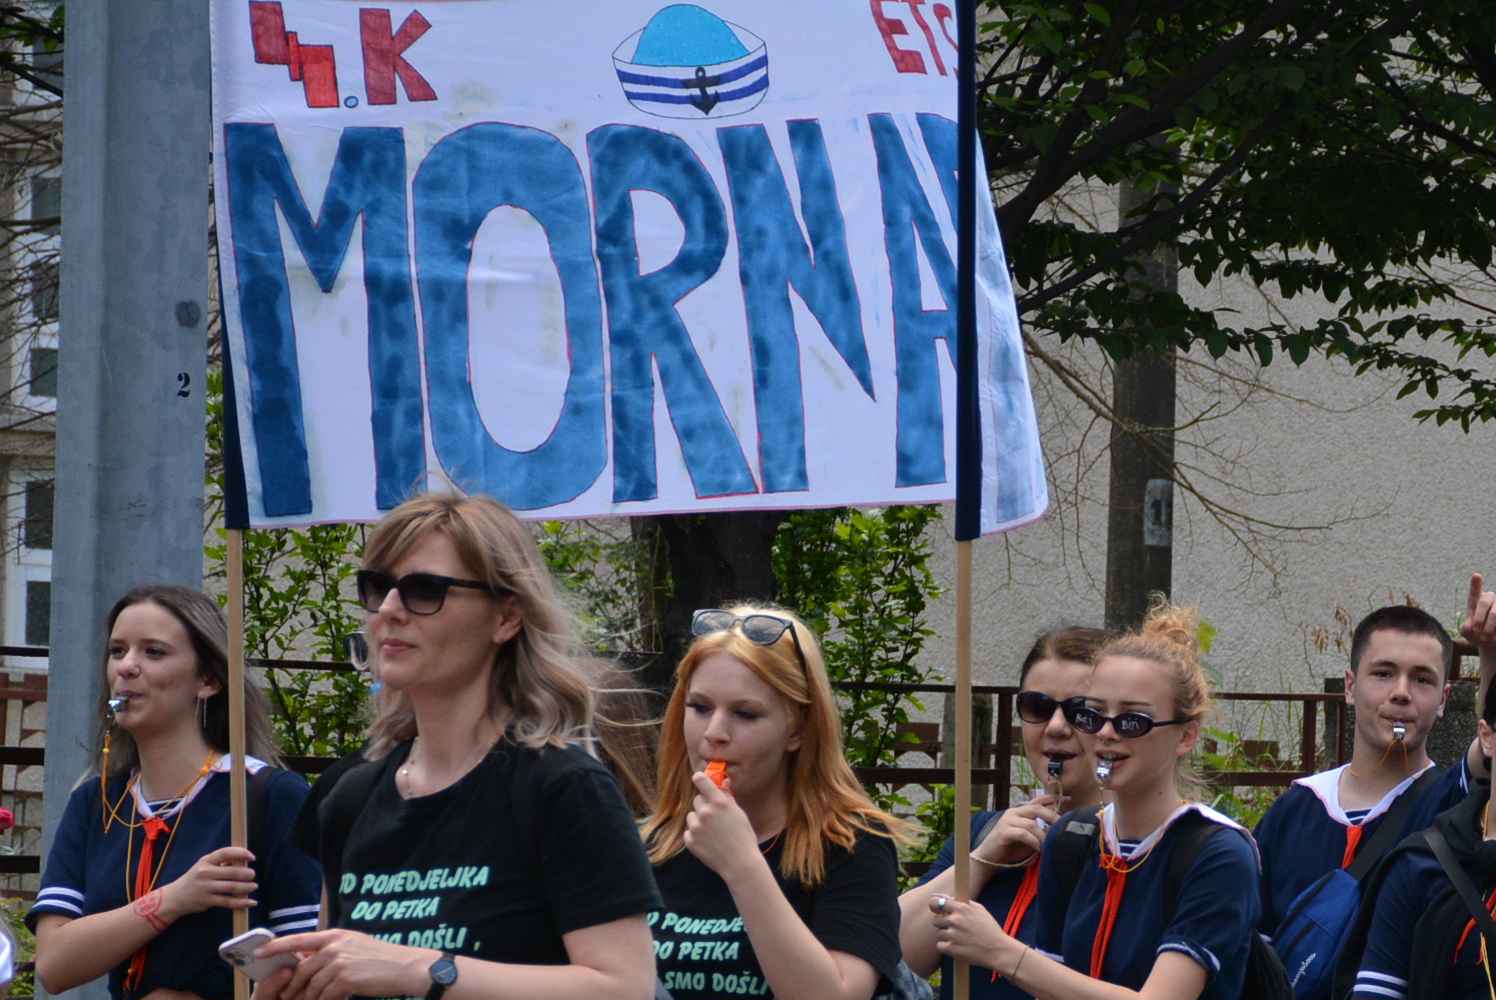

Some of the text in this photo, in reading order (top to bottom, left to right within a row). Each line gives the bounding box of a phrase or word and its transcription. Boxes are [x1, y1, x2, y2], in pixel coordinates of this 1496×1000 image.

[176, 372, 191, 398] 2
[351, 896, 441, 921] DO PETKA
[677, 941, 740, 961] PETKA
[664, 971, 706, 991] SMO
